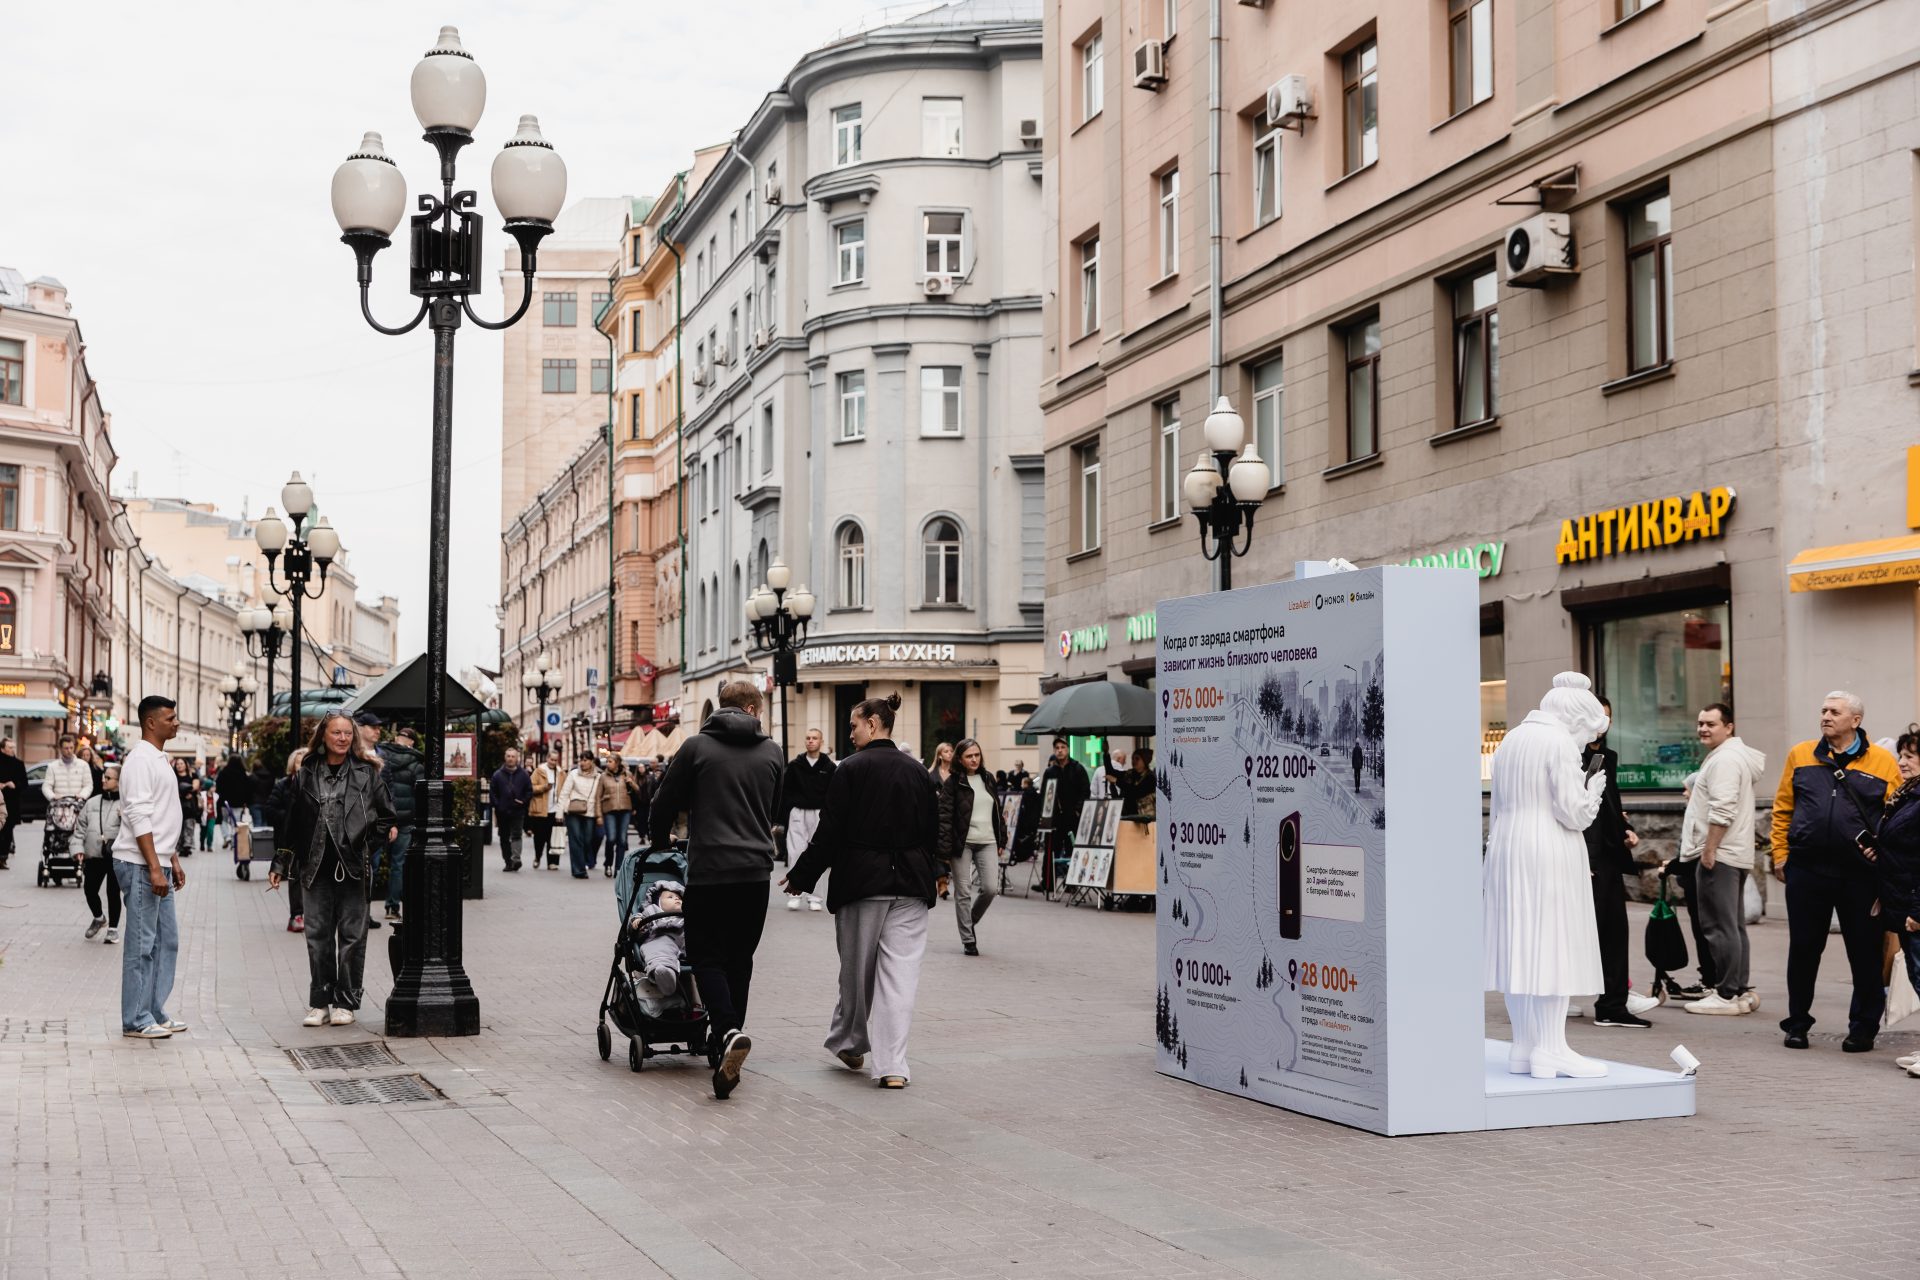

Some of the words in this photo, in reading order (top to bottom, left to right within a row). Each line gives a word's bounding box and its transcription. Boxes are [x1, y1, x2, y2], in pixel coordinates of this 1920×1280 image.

[1556, 487, 1733, 565] АНТИКВАР
[1857, 566, 1890, 584] кофе
[1288, 600, 1311, 610] LizaAlert
[1324, 594, 1345, 605] HONOR
[1356, 591, 1375, 602] билайн
[1163, 635, 1187, 651] Когда
[1188, 636, 1198, 648] от
[1200, 632, 1231, 649] заряда
[1232, 623, 1285, 644] смартфона
[889, 644, 955, 662] КУХНЯ
[1163, 657, 1196, 672] зависит
[1198, 655, 1225, 670] жизнь
[1227, 650, 1269, 667] близкого
[1270, 646, 1318, 662] человека
[1173, 688, 1192, 710] 376
[1195, 686, 1224, 708] 000+
[1172, 726, 1186, 734] людей
[1186, 726, 1206, 735] поступило
[1256, 755, 1280, 778] 282
[1282, 754, 1317, 779] 000+
[1180, 822, 1194, 844] 30
[1198, 823, 1227, 846] 000+
[1306, 866, 1328, 876] Смартфон
[1328, 868, 1360, 877] обеспечивает
[1316, 877, 1328, 886] дней
[1328, 878, 1344, 887] работы
[1310, 886, 1330, 896] батареей
[1334, 888, 1344, 897] 000
[1186, 960, 1198, 982] 10
[1202, 962, 1232, 986] 000+
[1301, 961, 1318, 988] 28
[1322, 964, 1358, 992] 000+
[1301, 994, 1318, 1002] заявок
[1318, 996, 1344, 1007] поступило
[1301, 1016, 1318, 1026] отряда
[1319, 1018, 1352, 1032] «ЛизаАлерт»
[1305, 1006, 1336, 1018] направление
[1336, 1010, 1350, 1020] «Пес
[1350, 1014, 1356, 1022] на
[1356, 1015, 1375, 1024] связи»
